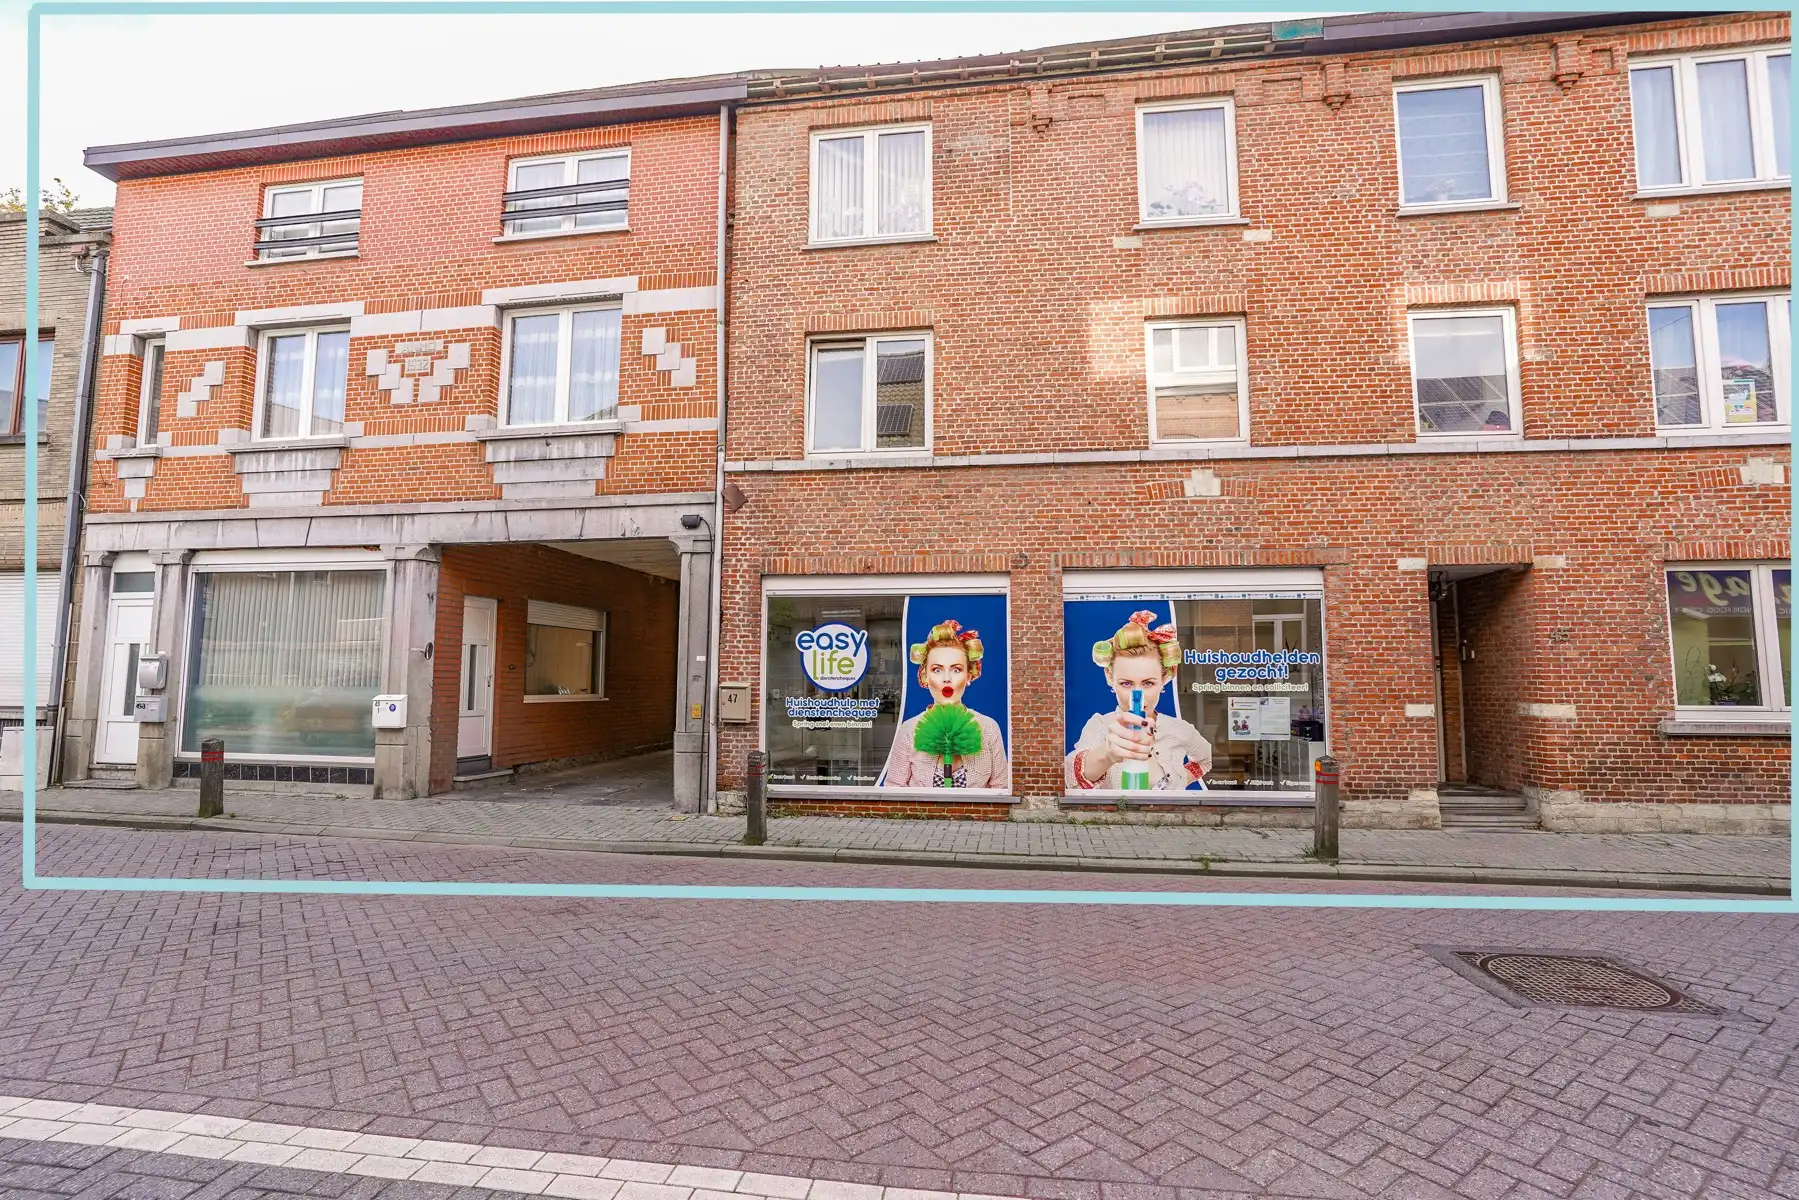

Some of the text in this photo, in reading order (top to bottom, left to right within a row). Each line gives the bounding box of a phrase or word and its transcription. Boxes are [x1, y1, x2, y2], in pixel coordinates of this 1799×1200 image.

[1551, 627, 1570, 641] 45
[797, 632, 866, 658] easy
[1184, 649, 1320, 664] Huishoudhelden
[812, 649, 855, 680] life
[1215, 664, 1289, 682] gezocht!
[1192, 682, 1308, 693] Spring binnen en solliciteer!
[728, 693, 738, 703] 47
[785, 696, 880, 710] Huishoudhulp met
[787, 707, 878, 719] dienstencheques
[792, 720, 814, 729] Spring
[846, 720, 872, 729] binnen!
